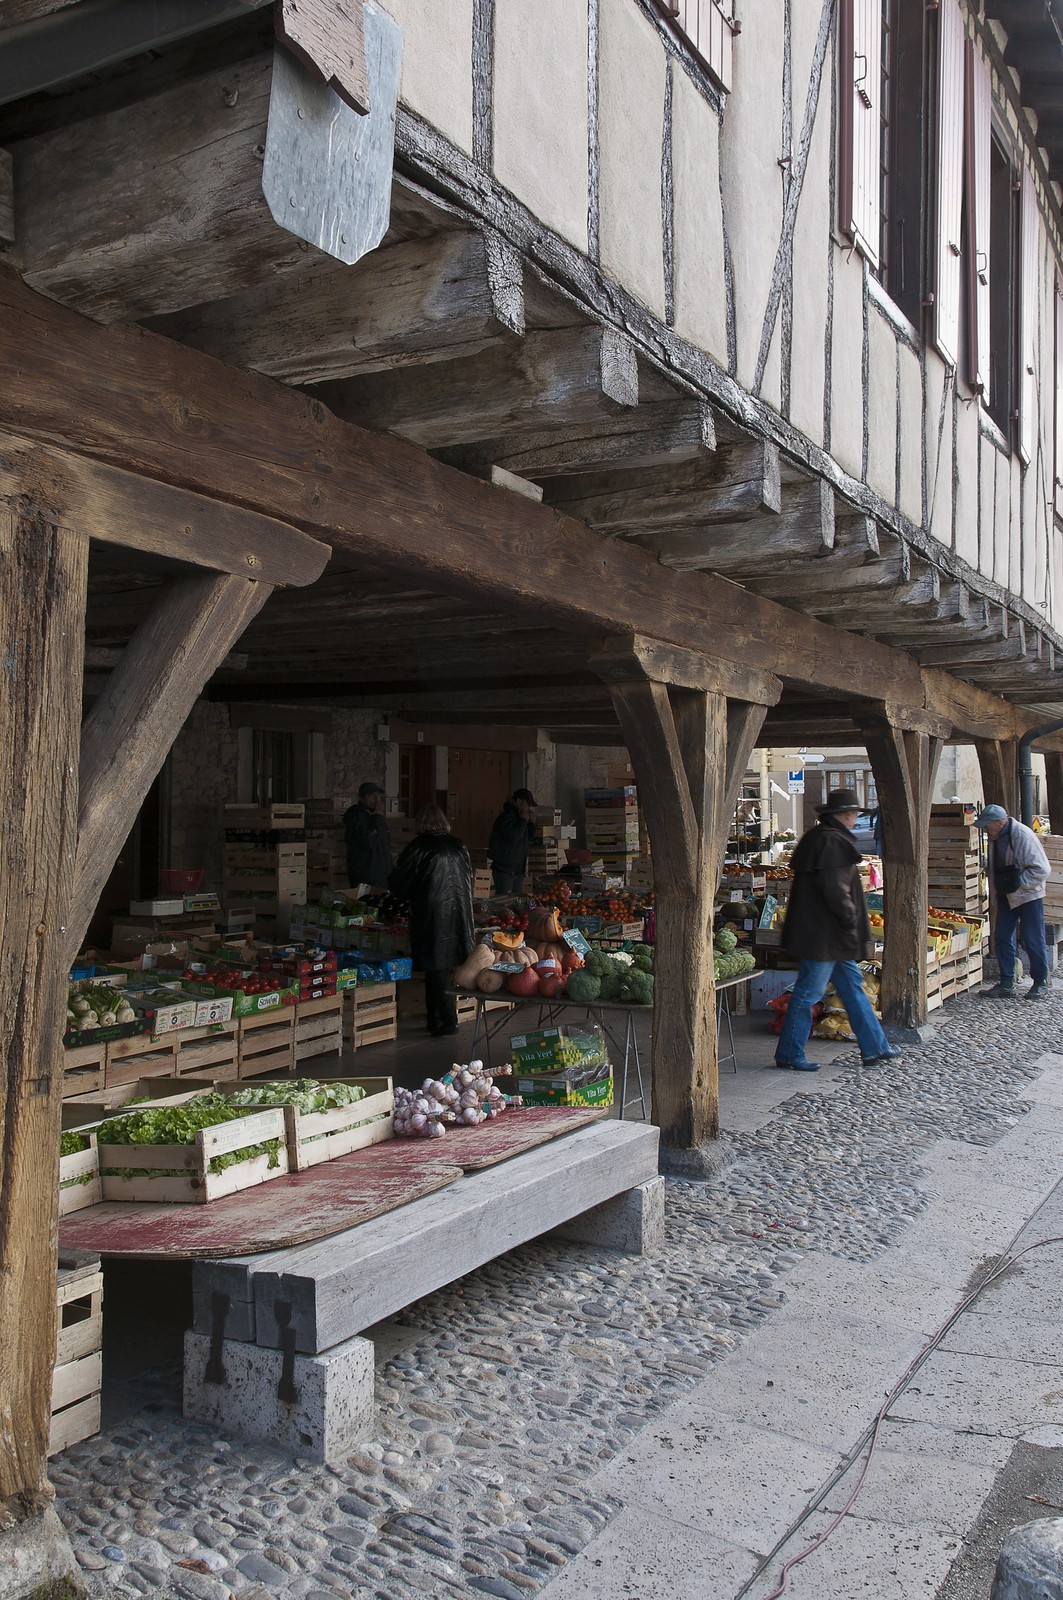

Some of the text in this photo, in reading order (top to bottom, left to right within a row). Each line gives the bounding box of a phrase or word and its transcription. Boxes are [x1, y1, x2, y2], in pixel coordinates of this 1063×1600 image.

[520, 1049, 553, 1062] Vita Vert
[587, 1085, 607, 1099] Vita Vert
